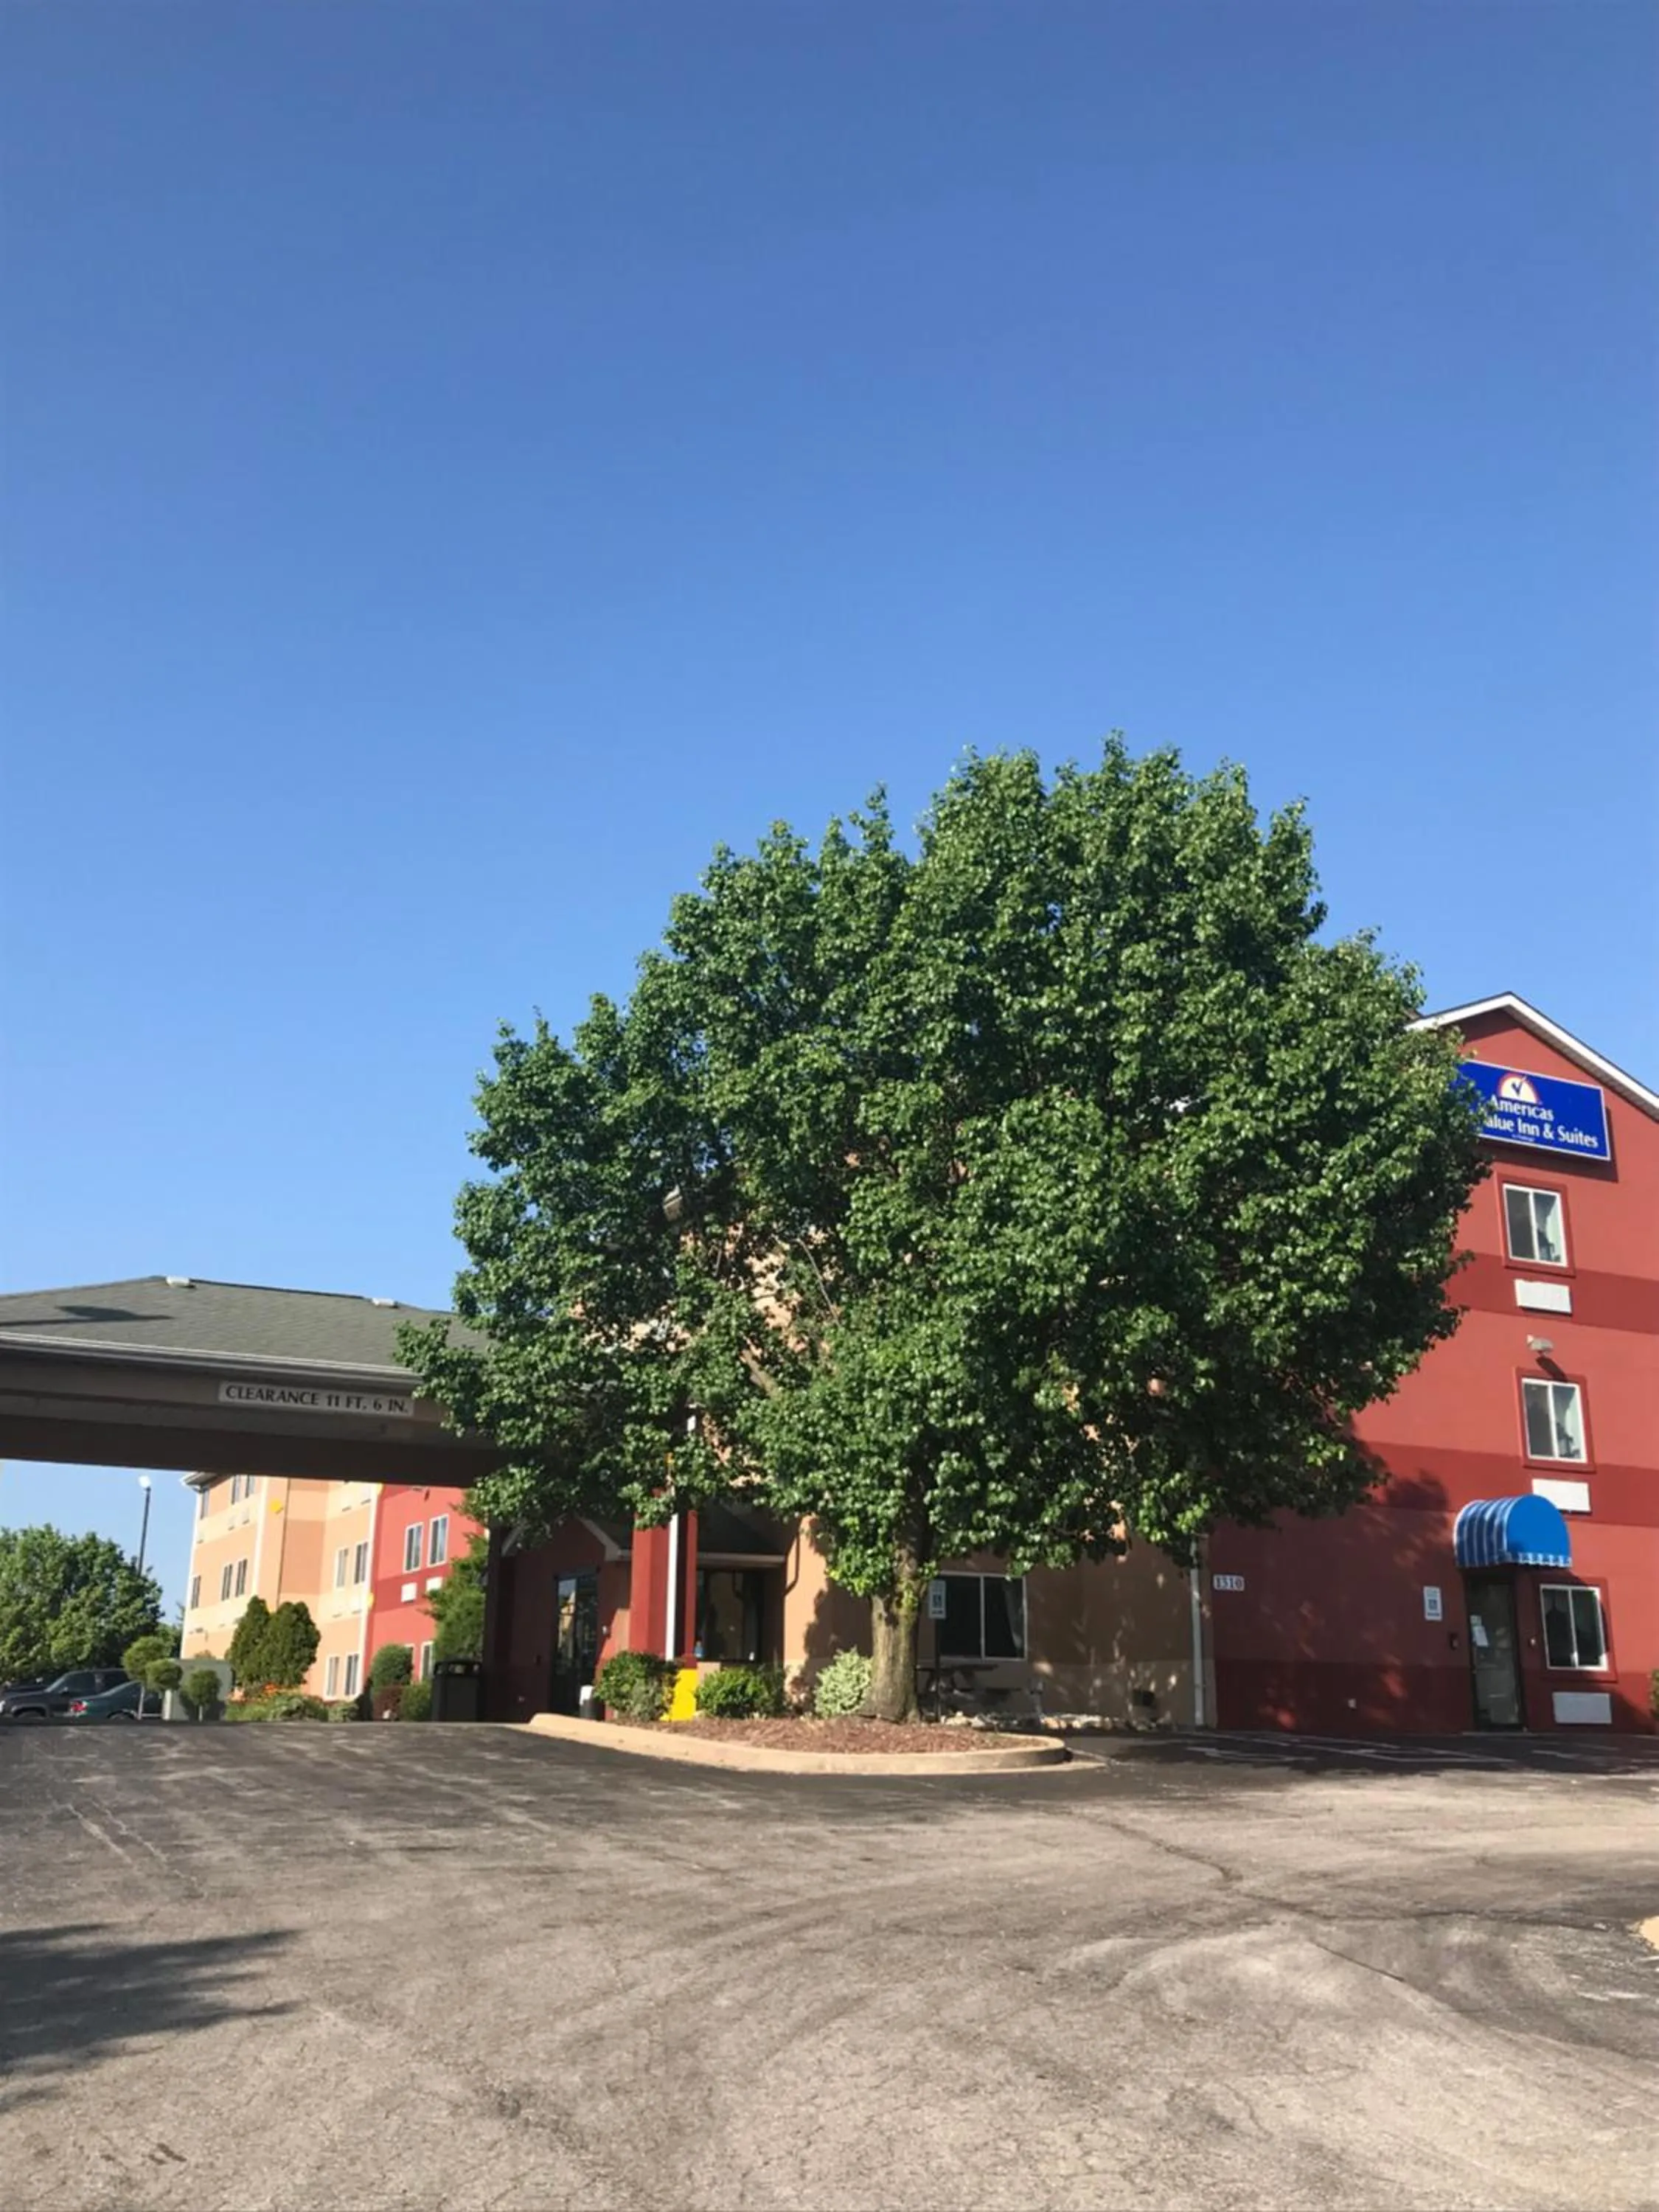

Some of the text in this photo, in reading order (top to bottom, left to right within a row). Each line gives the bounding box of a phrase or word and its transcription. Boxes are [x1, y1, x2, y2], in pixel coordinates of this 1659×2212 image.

[1488, 1094, 1554, 1121] Americas
[1484, 1113, 1514, 1132] alue
[1517, 1118, 1540, 1137] Inn
[1543, 1123, 1554, 1140] &
[1558, 1127, 1599, 1148] Suites
[226, 1385, 319, 1406] CLEARANCE
[372, 1397, 383, 1411] 6
